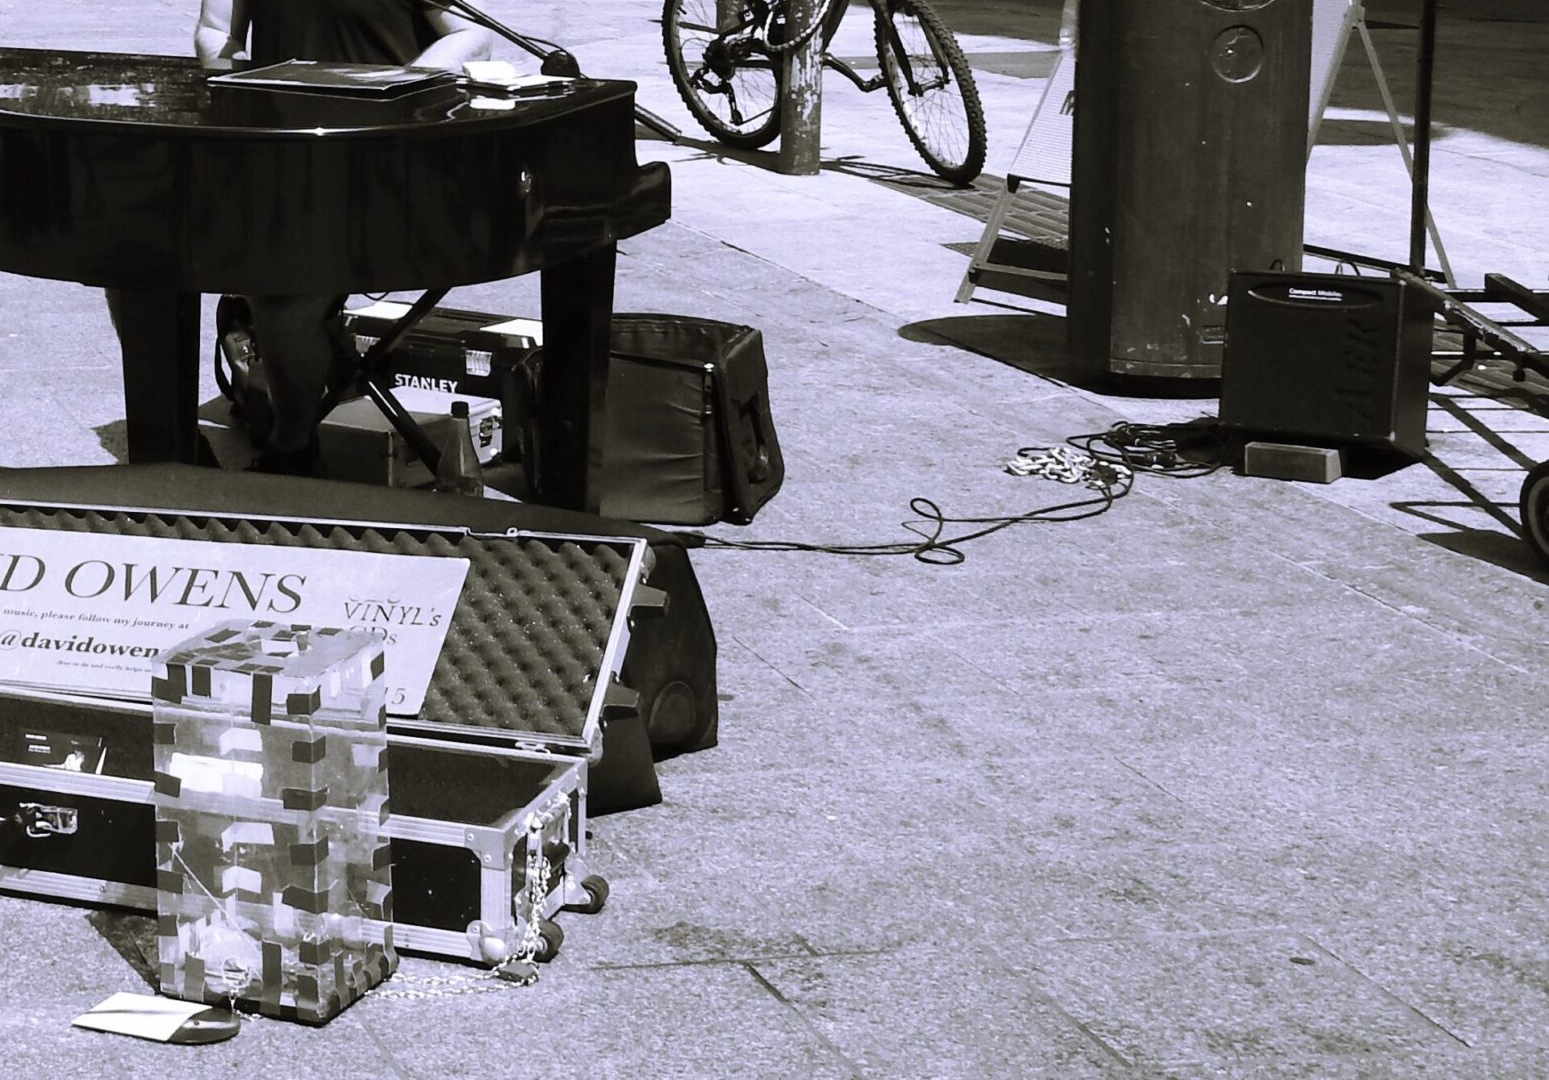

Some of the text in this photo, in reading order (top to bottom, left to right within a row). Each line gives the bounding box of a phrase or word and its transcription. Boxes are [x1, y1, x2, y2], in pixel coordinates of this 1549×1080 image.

[394, 373, 458, 394] STANLEY
[63, 559, 308, 615] OWENS
[3, 608, 39, 618] music,
[41, 609, 76, 621] please
[78, 610, 110, 623] follow
[113, 617, 131, 627] my
[132, 618, 175, 631] journey
[176, 622, 190, 631] at
